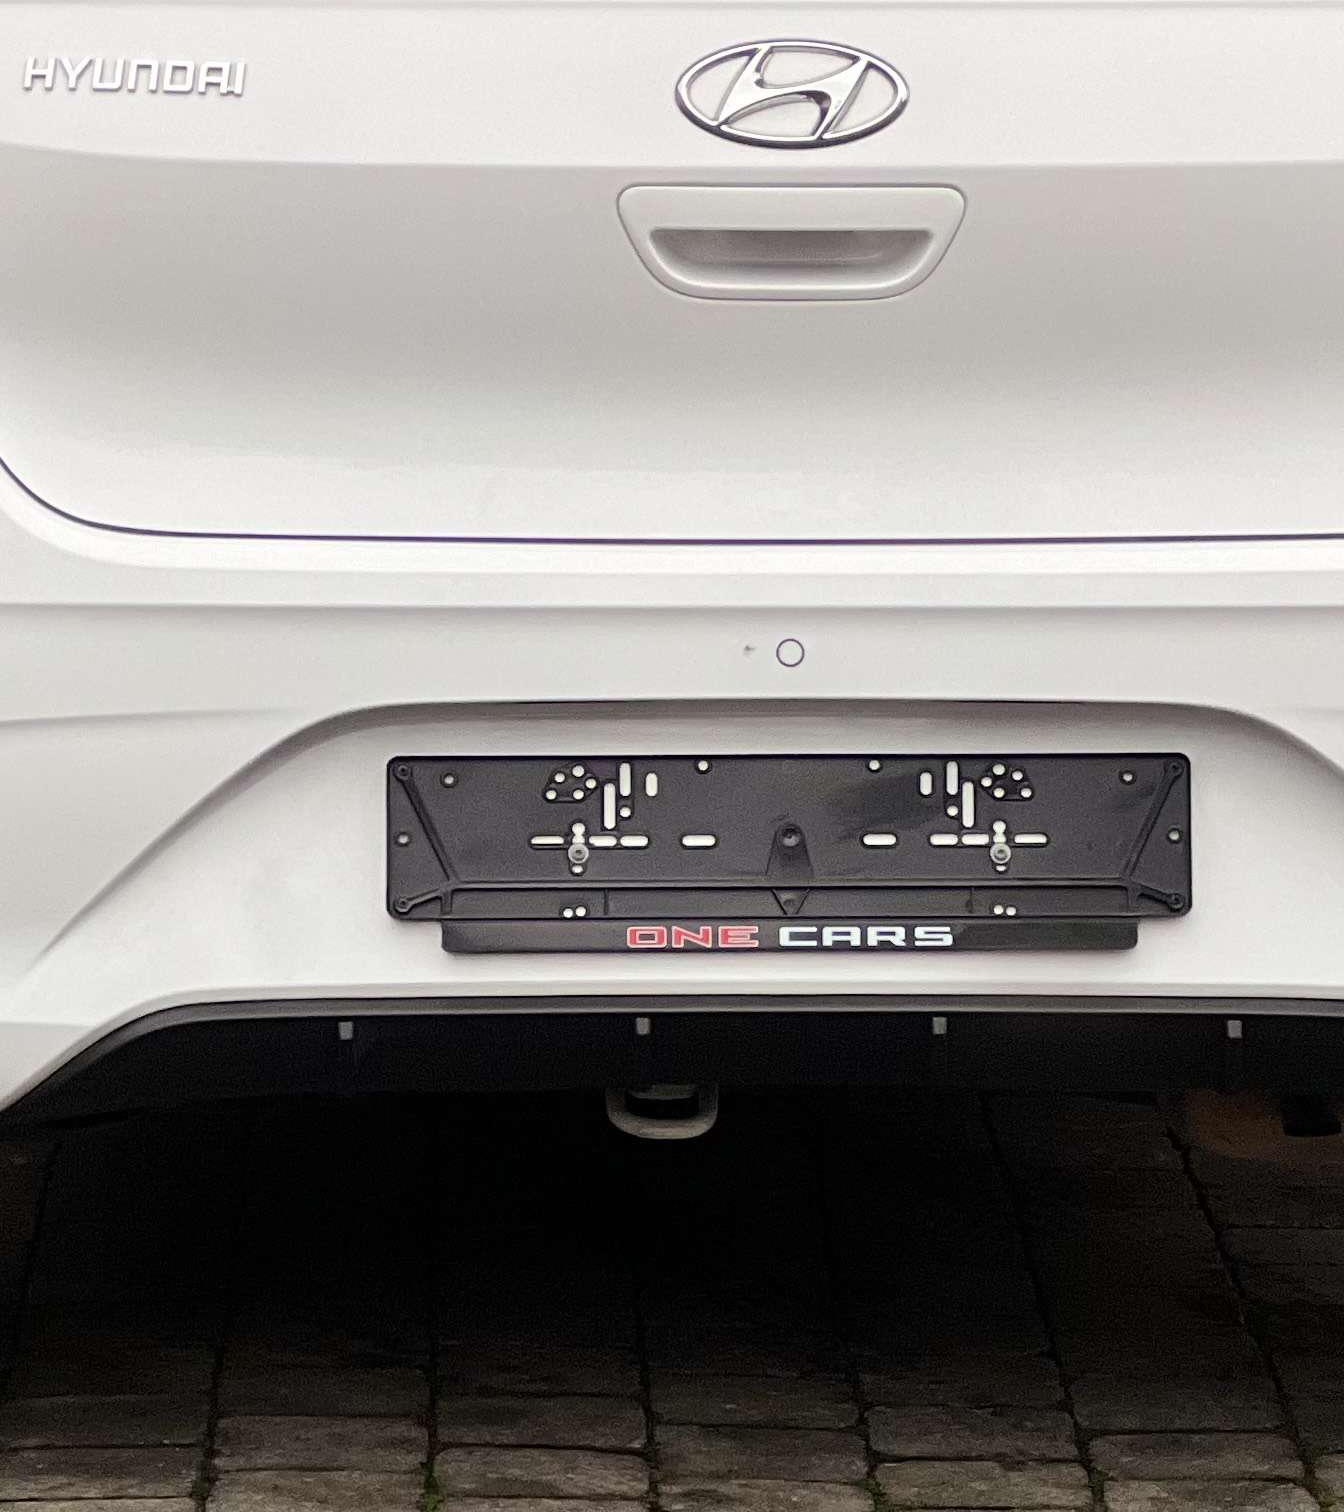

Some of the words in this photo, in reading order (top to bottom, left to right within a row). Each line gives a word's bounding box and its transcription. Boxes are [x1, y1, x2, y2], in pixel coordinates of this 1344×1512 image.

[23, 55, 246, 97] HYUNDAI
[626, 925, 759, 949] ONE
[778, 925, 954, 948] CARS
